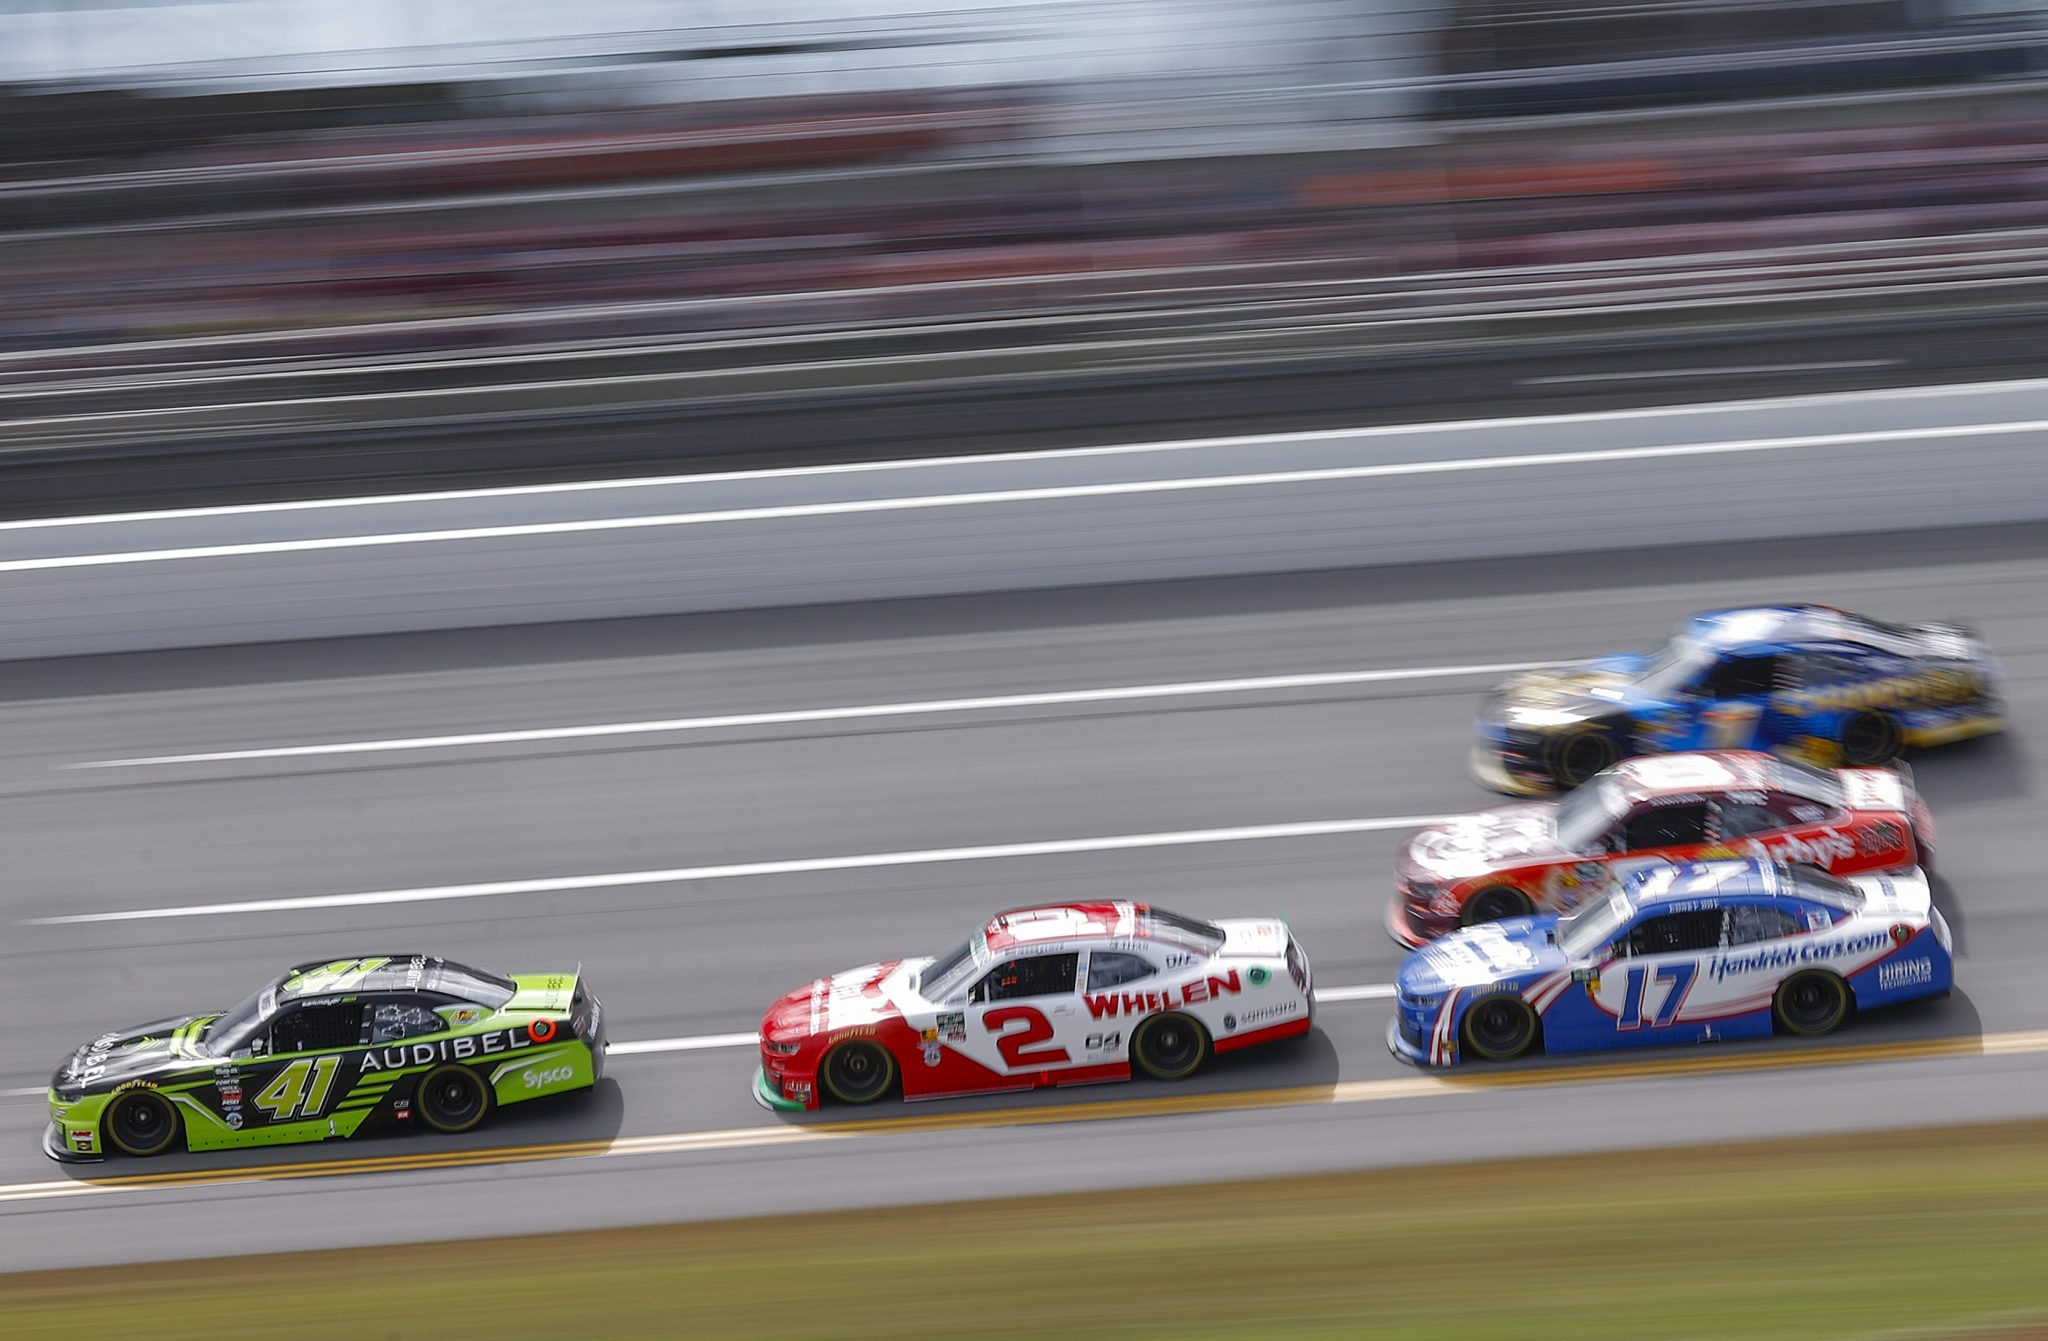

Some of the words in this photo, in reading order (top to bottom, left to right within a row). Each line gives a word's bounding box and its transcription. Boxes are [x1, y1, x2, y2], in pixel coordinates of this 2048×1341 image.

[1709, 932, 1889, 983] HendrickCars.com
[1083, 968, 1242, 1021] WHELEN
[1616, 958, 1699, 1032] 17
[359, 1029, 532, 1073] AUDIBEL
[983, 1006, 1071, 1067] 2
[111, 1079, 158, 1095] GOODYEAR
[253, 1056, 342, 1121] 41
[523, 1065, 574, 1090] Sysco
